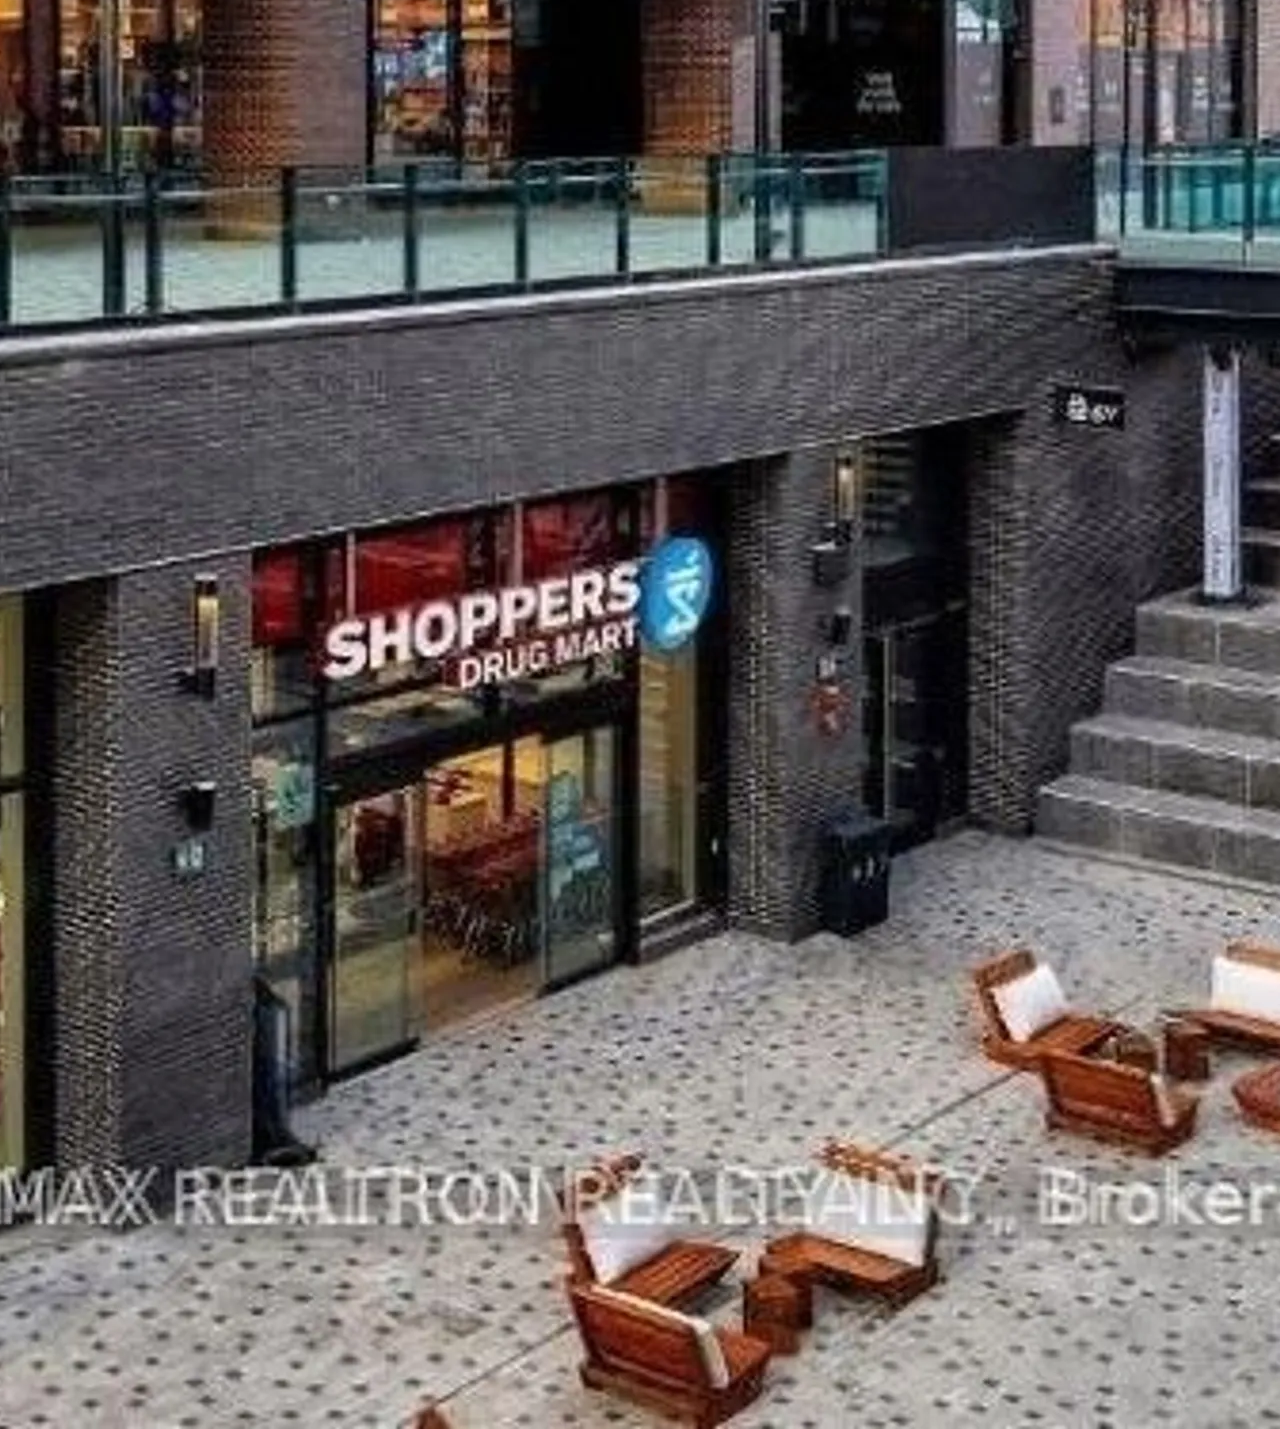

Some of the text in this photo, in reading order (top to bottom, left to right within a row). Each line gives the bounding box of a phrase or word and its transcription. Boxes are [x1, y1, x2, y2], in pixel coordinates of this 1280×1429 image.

[323, 559, 641, 680] SHOPPERS
[458, 617, 641, 690] DRUG MART
